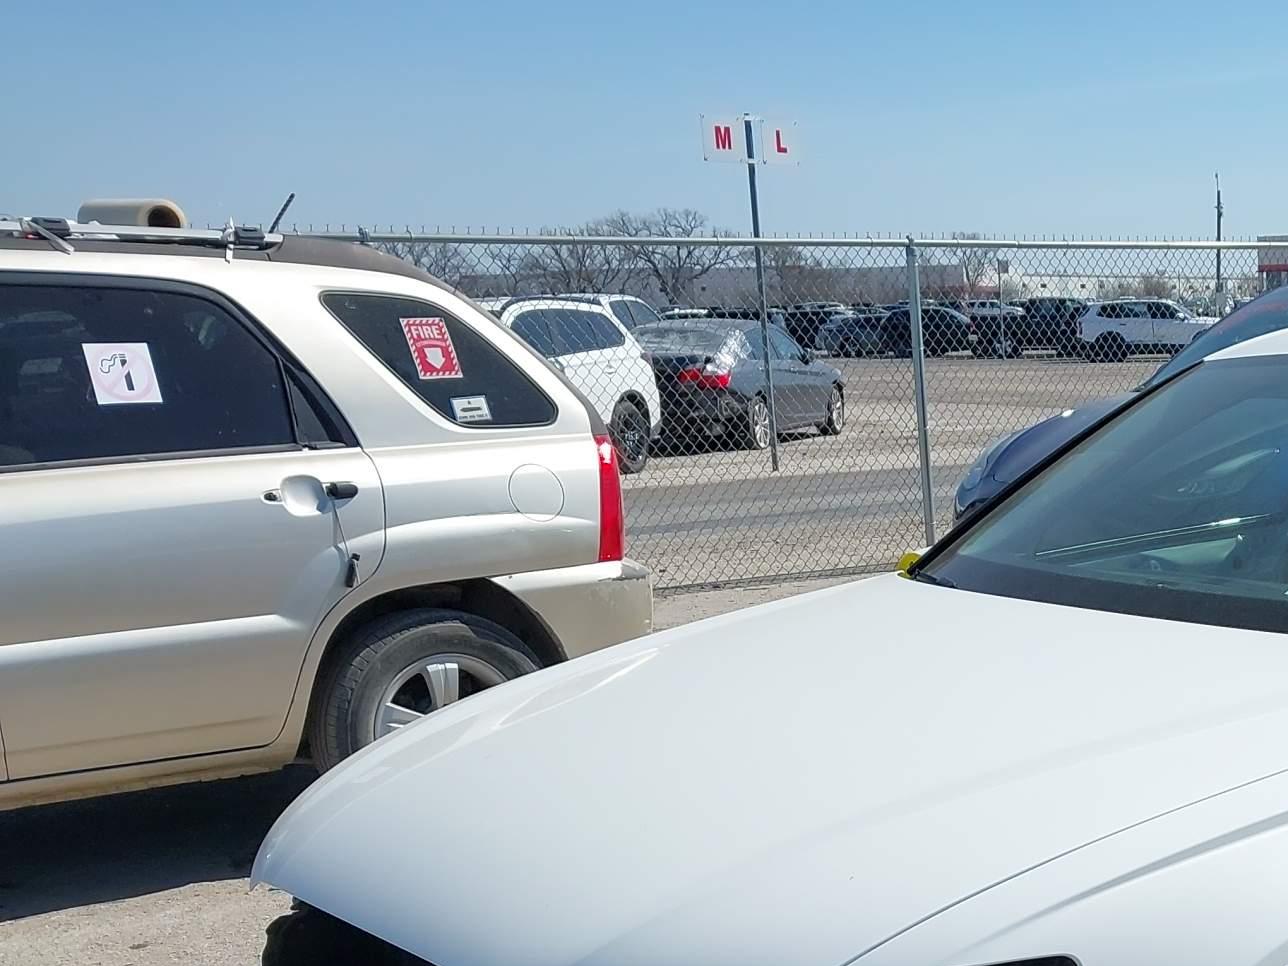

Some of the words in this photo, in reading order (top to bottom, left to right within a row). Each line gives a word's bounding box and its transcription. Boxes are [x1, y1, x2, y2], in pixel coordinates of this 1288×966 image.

[714, 125, 732, 150] M
[775, 129, 788, 153] L
[410, 325, 442, 339] FIRE
